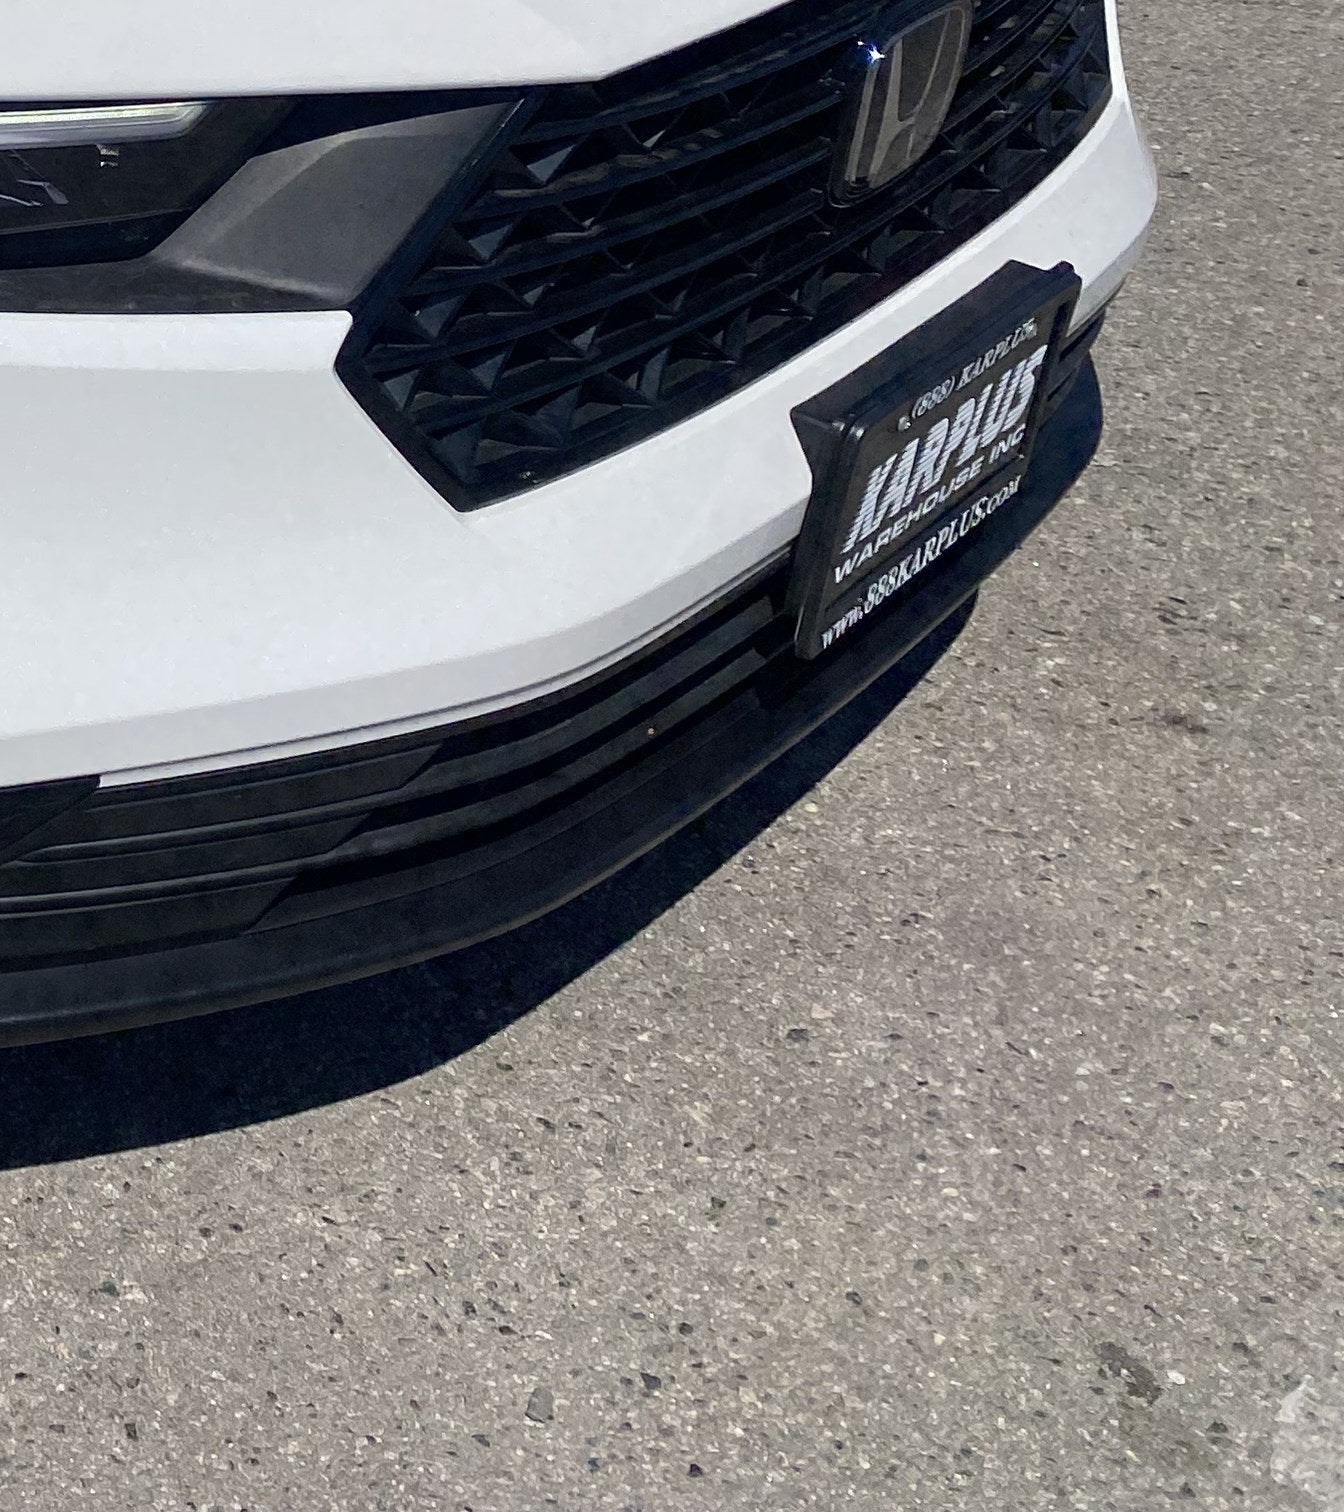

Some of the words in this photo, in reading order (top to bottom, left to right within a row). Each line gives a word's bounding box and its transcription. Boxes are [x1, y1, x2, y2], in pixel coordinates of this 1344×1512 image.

[839, 345, 1048, 555] KARPLUS
[912, 375, 956, 419] (888)
[821, 474, 1022, 650] www.888KARPLUS.com
[834, 455, 985, 584] WAREHOUSE
[989, 422, 1026, 465] INC
